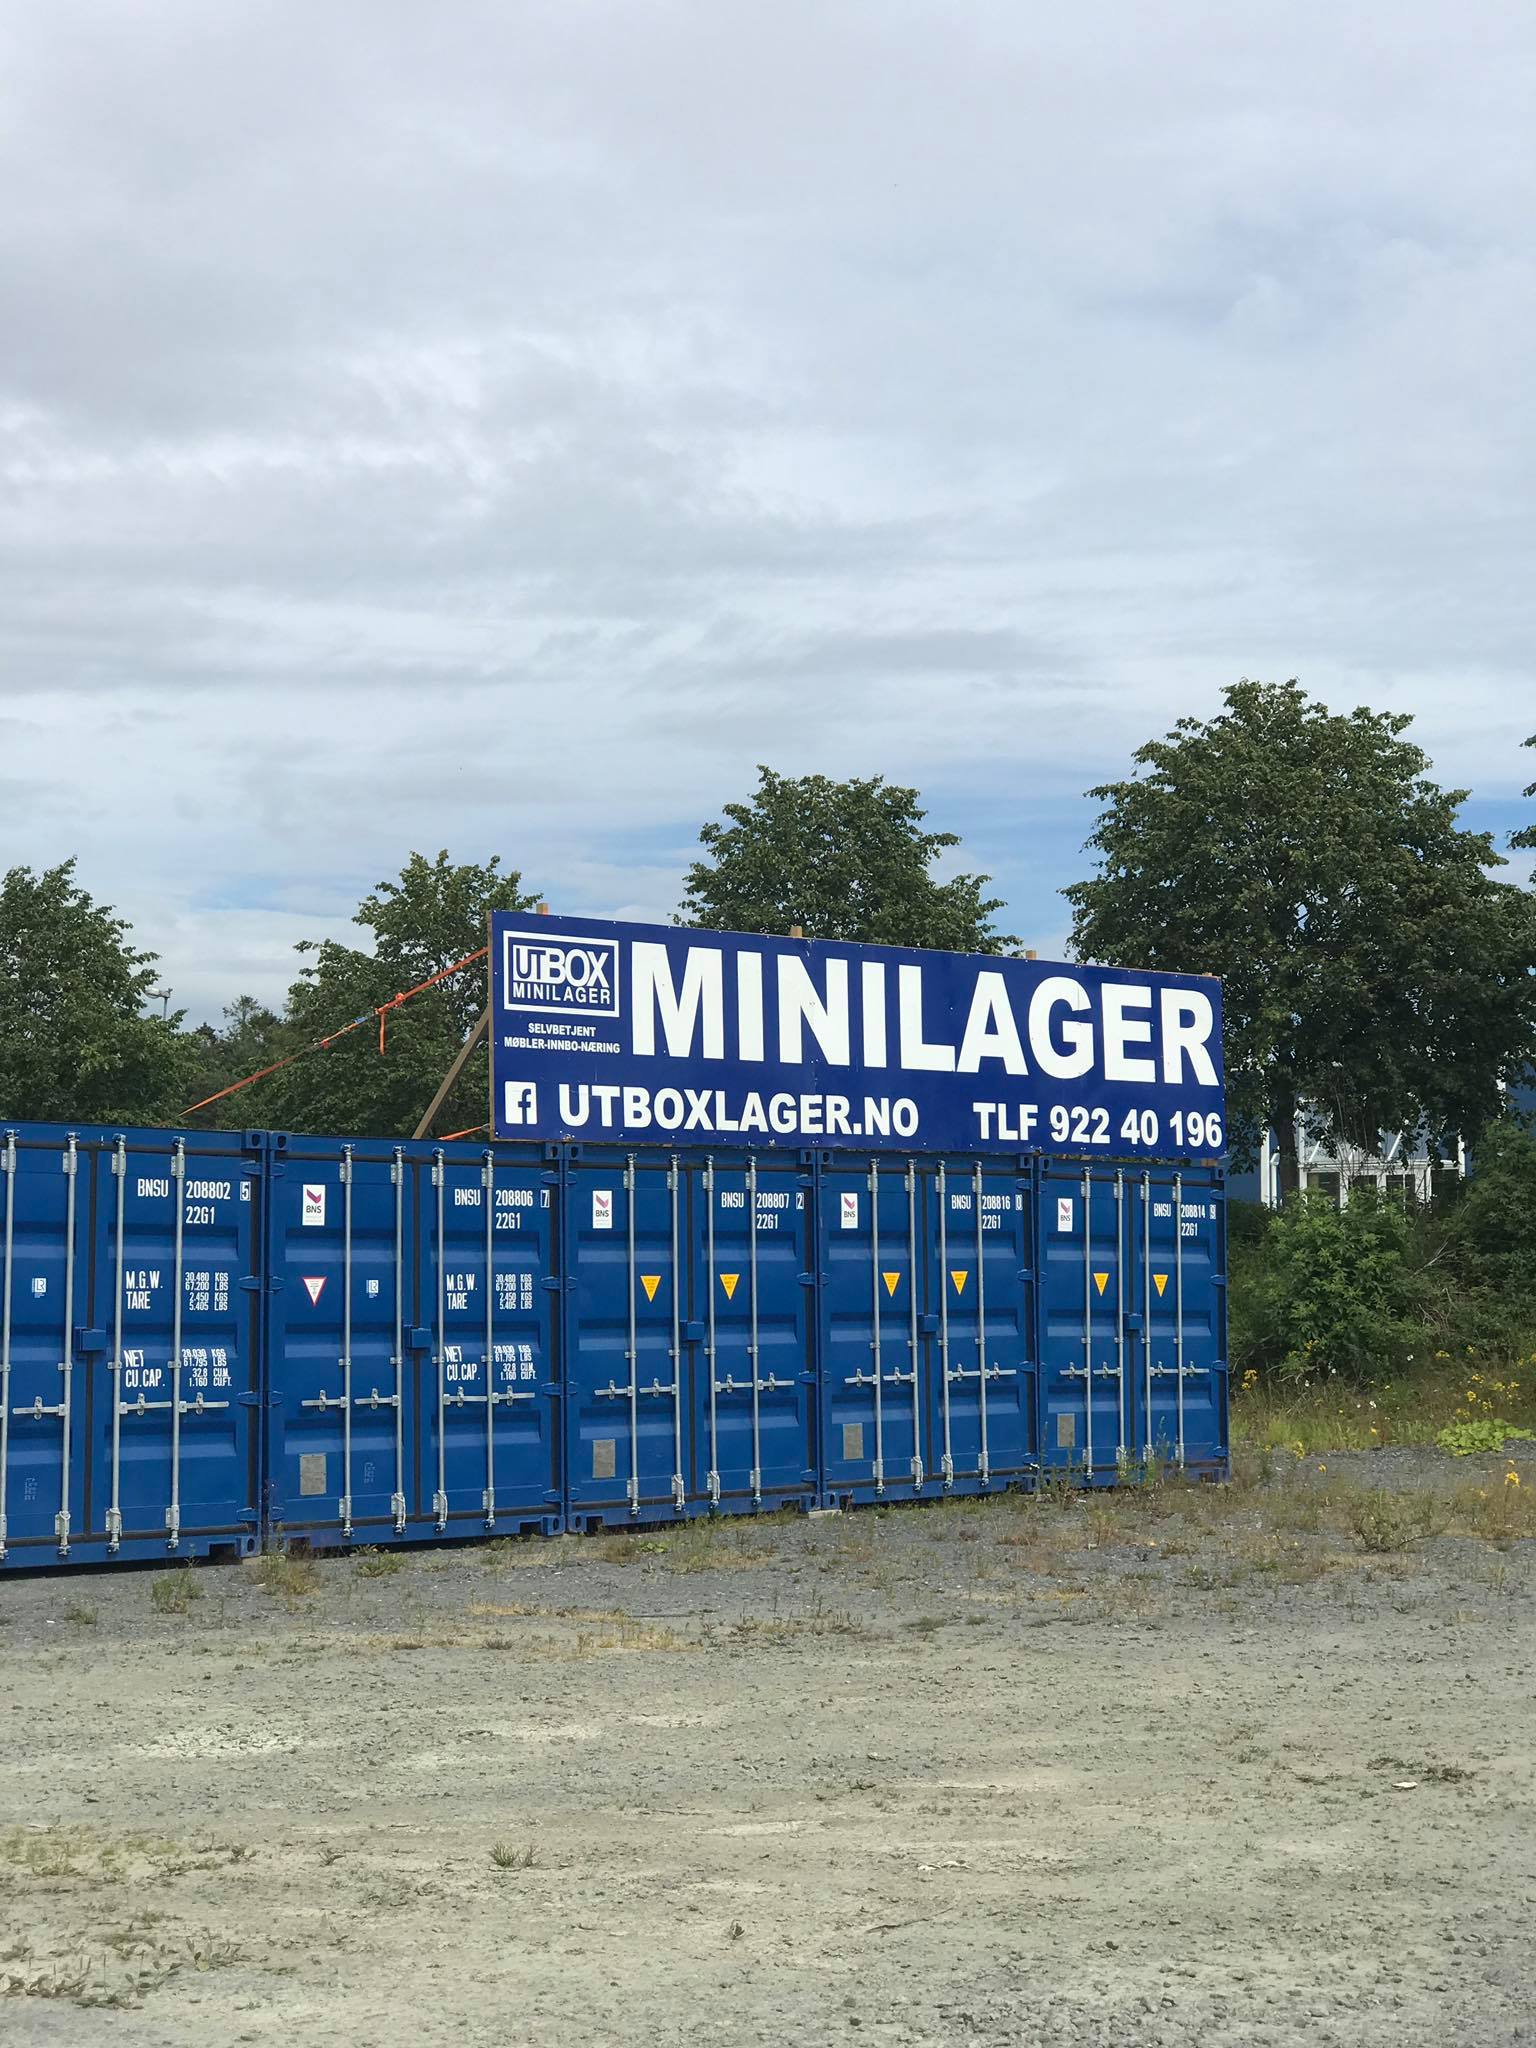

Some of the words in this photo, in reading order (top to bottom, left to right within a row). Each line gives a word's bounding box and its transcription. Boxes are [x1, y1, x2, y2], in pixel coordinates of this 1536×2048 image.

[513, 981, 610, 1005] MINILAGER
[631, 940, 1220, 1087] MINILAGER
[528, 1022, 597, 1037] SELVBETJENT
[504, 1036, 621, 1054] MØBLER-INNBO-NÆRING
[558, 1083, 919, 1137] UTBOXLAGER.NO
[972, 1101, 1039, 1141] TLF
[1049, 1105, 1111, 1145] 922
[1120, 1108, 1159, 1146] 40
[1169, 1110, 1223, 1148] 196
[137, 1178, 169, 1198] BNSU
[185, 1180, 231, 1200] 208802
[240, 1181, 250, 1200] 5
[454, 1188, 481, 1206] BNSU
[495, 1189, 534, 1207] 208806
[721, 1191, 745, 1208] BNSU
[756, 1192, 790, 1209] 208807
[796, 1193, 804, 1209] 2
[951, 1194, 972, 1210] BNSU
[981, 1195, 1011, 1210] 208816
[185, 1205, 215, 1225] 22G1
[305, 1205, 322, 1214] BNS
[595, 1209, 610, 1218] BNS
[843, 1210, 856, 1218] BNS
[1153, 1202, 1172, 1218] BNSU
[495, 1212, 520, 1230] 22G1
[756, 1213, 779, 1230] 22G1
[982, 1214, 1001, 1230] 22G1
[1181, 1222, 1198, 1237] 22G1
[125, 1270, 164, 1290] M.G.W.
[184, 1272, 209, 1282] 30.480
[214, 1272, 229, 1282] KGS
[446, 1273, 478, 1291] M.G.W.
[184, 1282, 209, 1291] 67.200
[214, 1282, 229, 1291] LBS
[125, 1291, 152, 1310] TARE
[189, 1292, 209, 1301] 2.450
[214, 1292, 228, 1301] KGS
[446, 1292, 468, 1310] TARE
[214, 1301, 228, 1311] LBS
[123, 1349, 144, 1368] NET
[444, 1345, 463, 1362] NET
[125, 1368, 166, 1388] CU.CAP.
[446, 1363, 480, 1381] CU.CAP.
